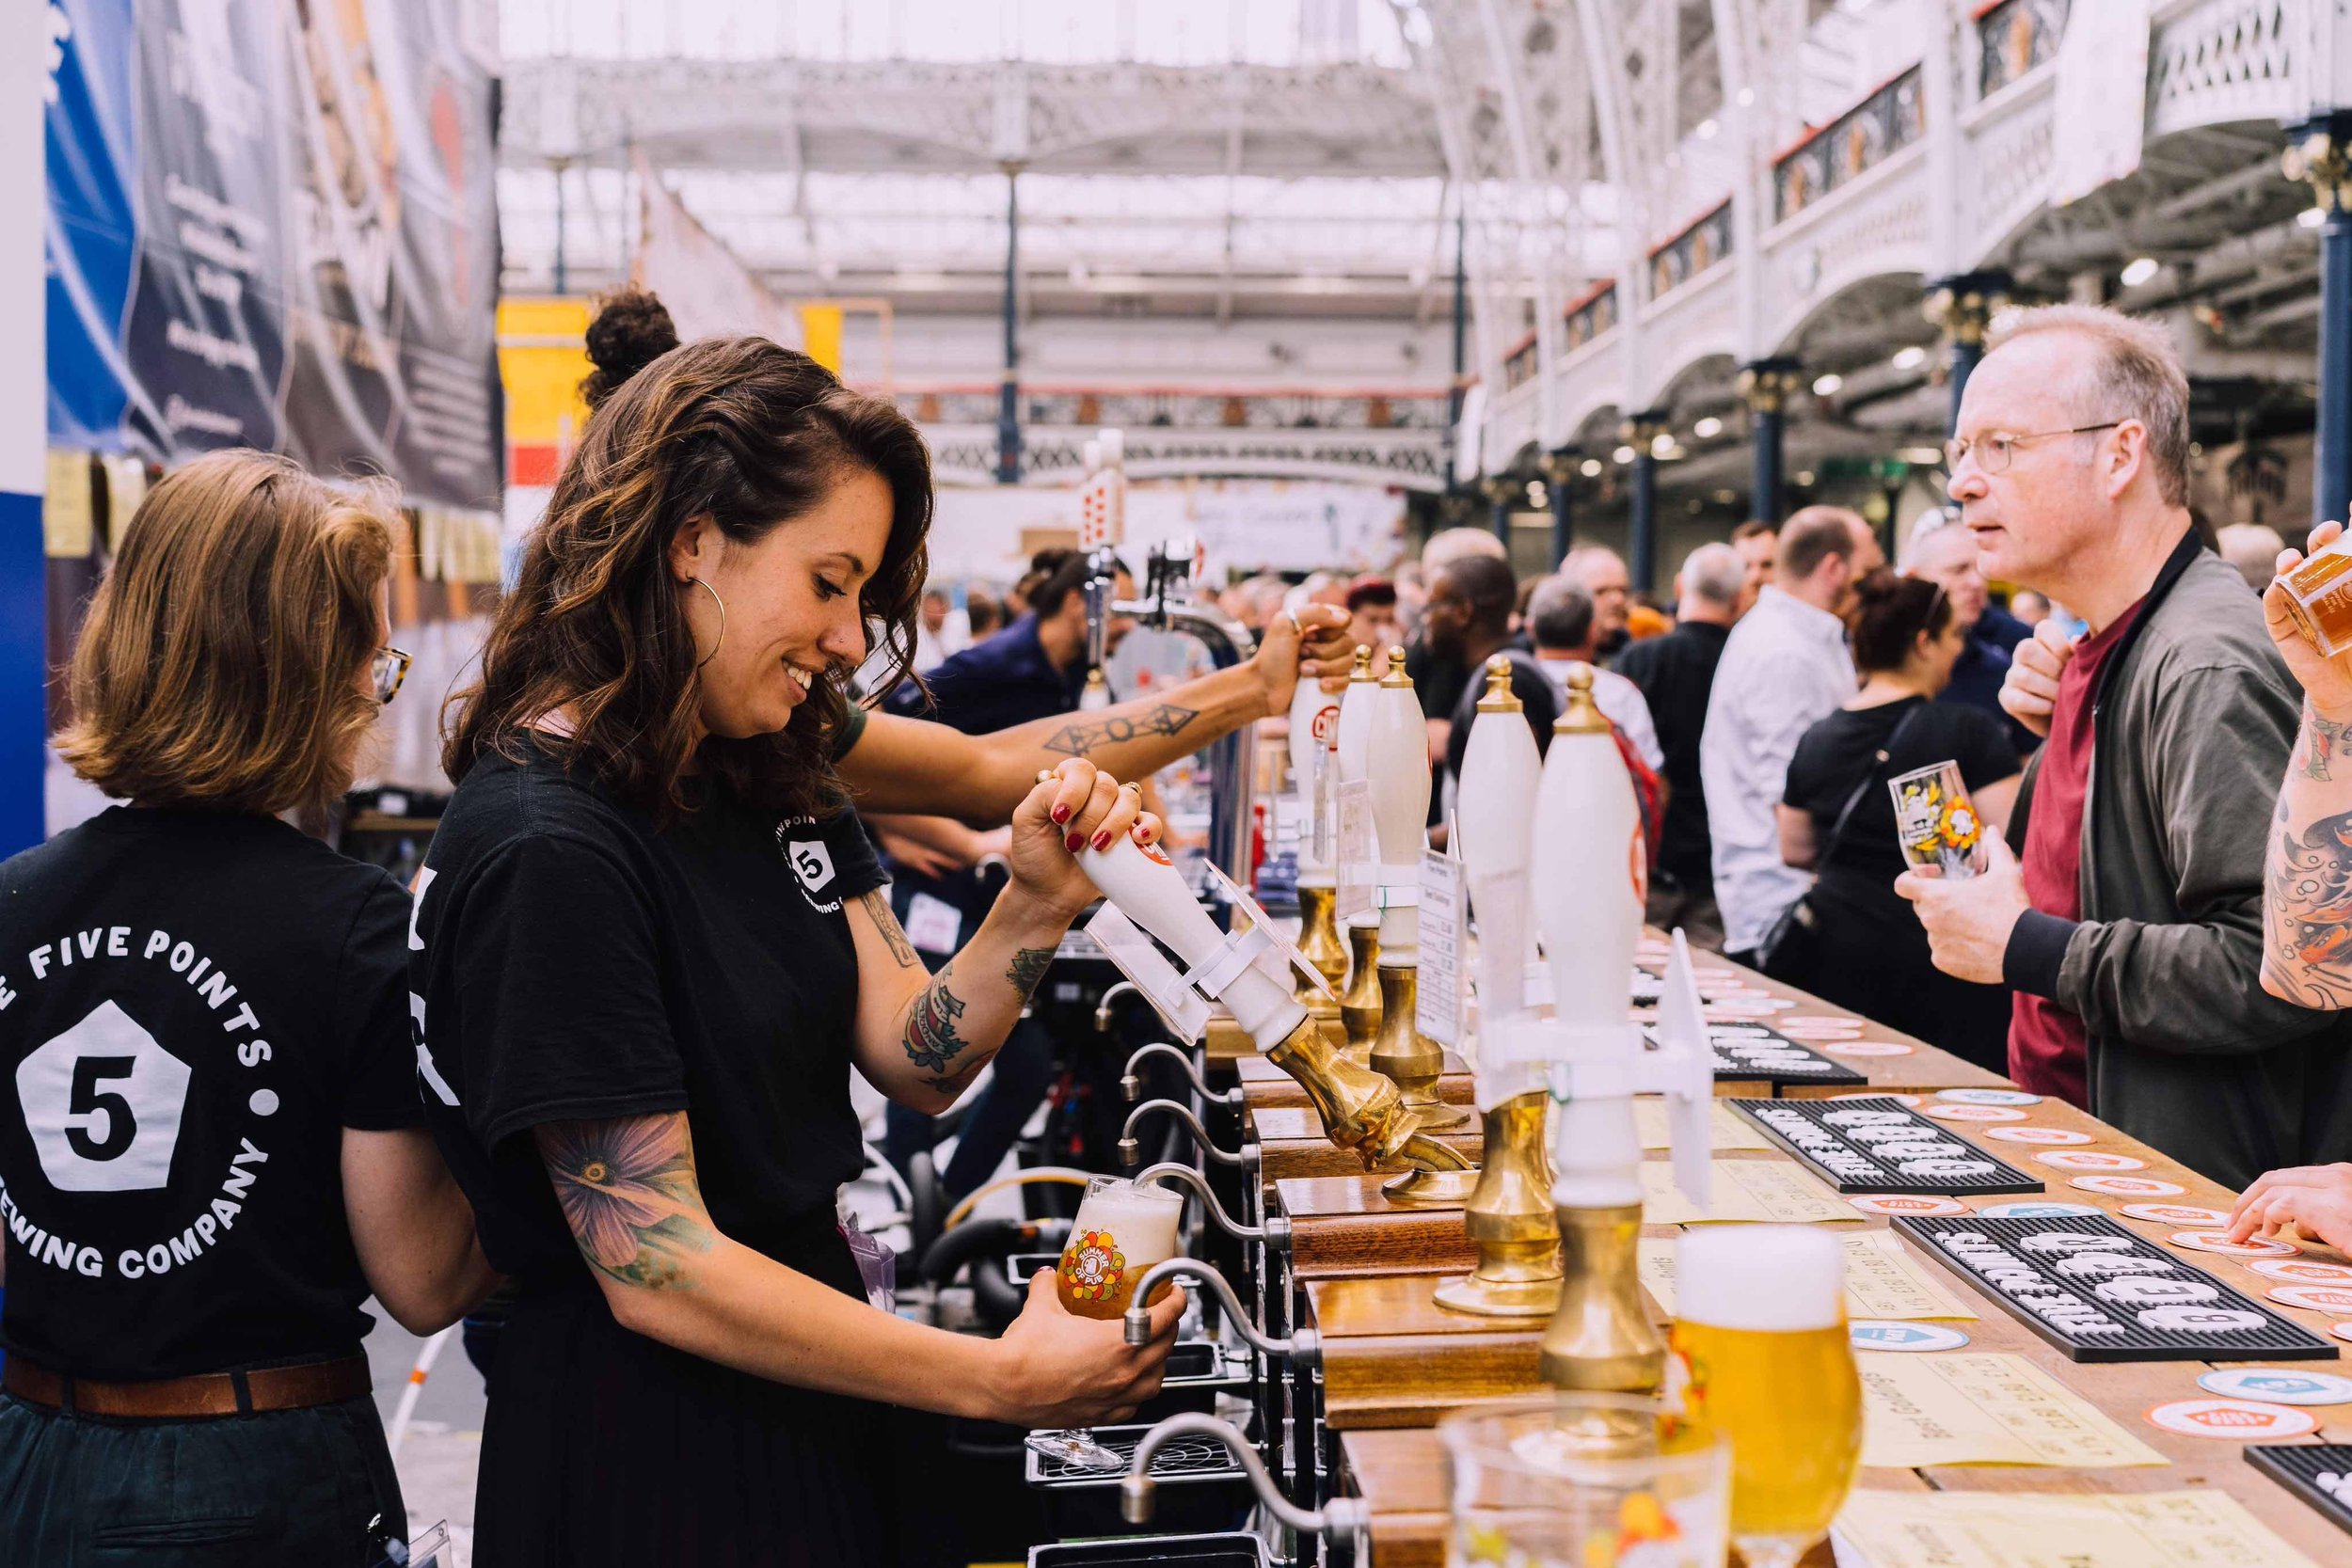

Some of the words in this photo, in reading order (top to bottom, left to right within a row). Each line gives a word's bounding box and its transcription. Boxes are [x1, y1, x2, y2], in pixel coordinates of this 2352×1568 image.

[785, 816, 816, 829] POIN
[796, 849, 823, 879] 5
[29, 927, 131, 979] FIVE
[144, 929, 272, 1068] POINTS
[64, 1055, 137, 1162] 5
[1755, 1108, 1845, 1151] POINTS
[1808, 1148, 1884, 1177] FIVE
[0, 1175, 103, 1277] EWING
[119, 1137, 268, 1279] COMPANY
[1075, 1267, 1085, 1279] OF
[1085, 1275, 1104, 1285] PUB
[1078, 1246, 1110, 1268] SUMMER
[1934, 1231, 2061, 1292] POINTS
[2018, 1292, 2126, 1337] FIVE
